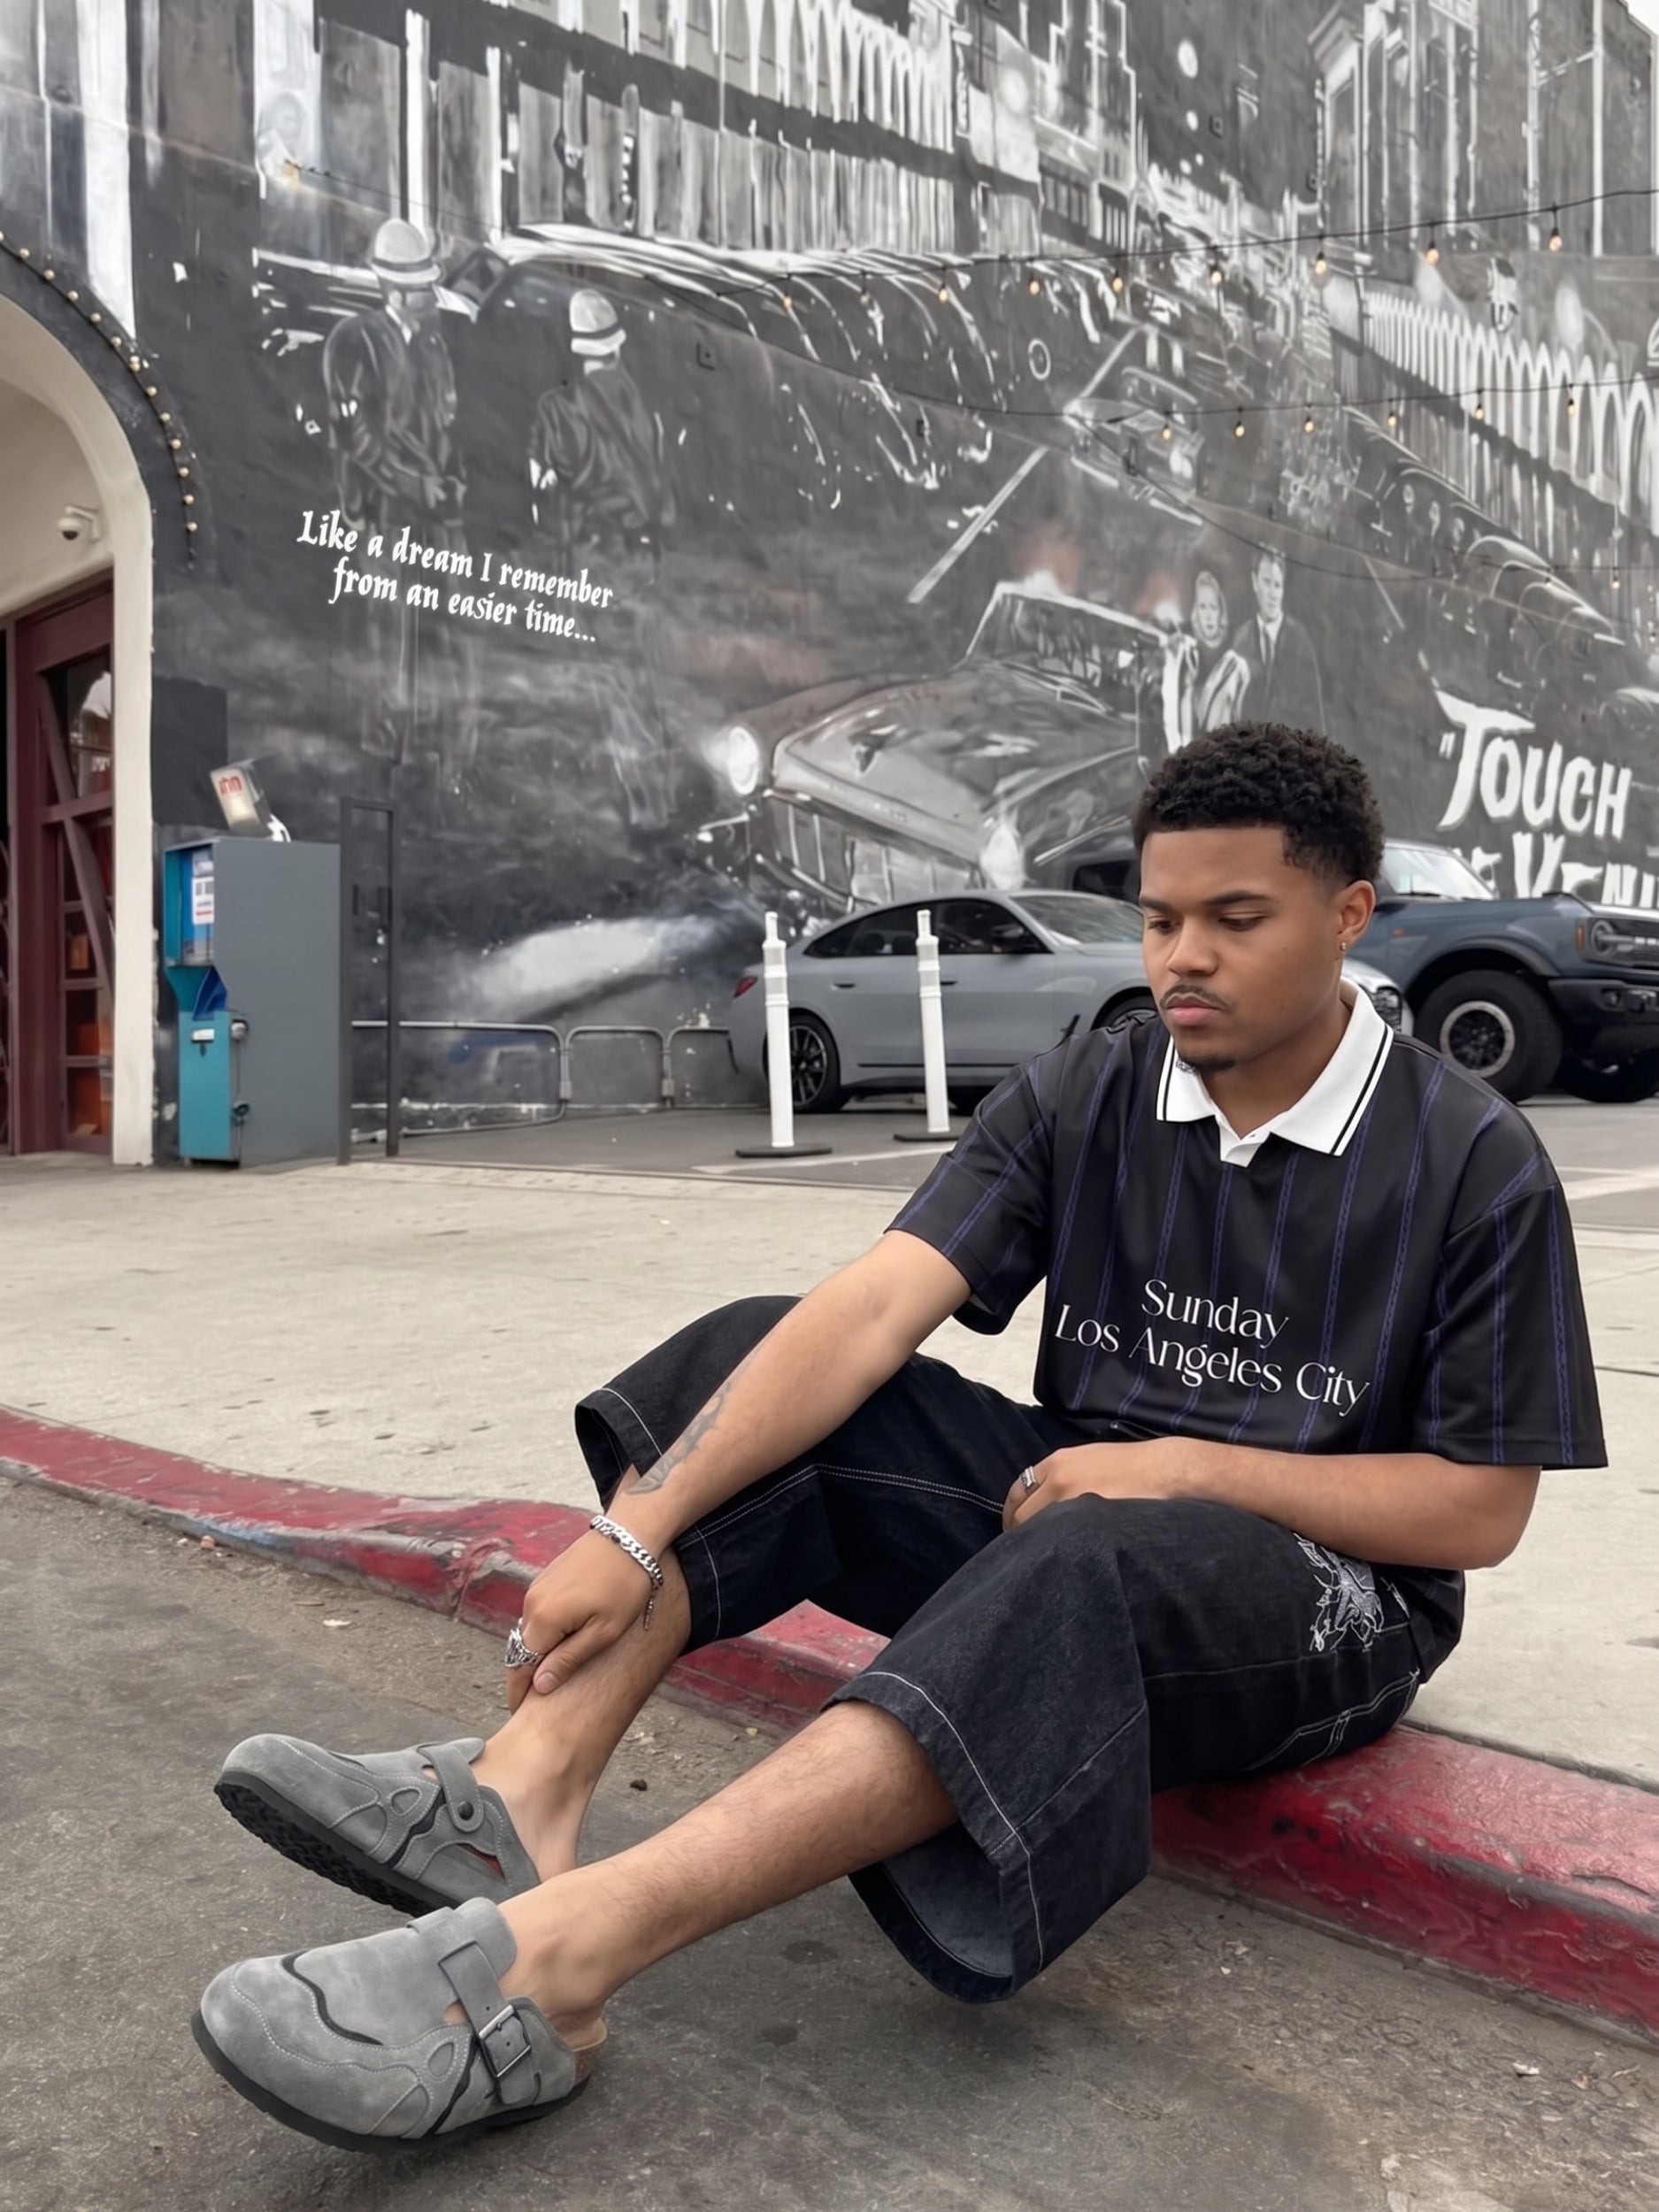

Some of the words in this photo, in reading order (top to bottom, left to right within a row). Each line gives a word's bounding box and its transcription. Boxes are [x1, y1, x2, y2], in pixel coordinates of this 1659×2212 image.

[296, 509, 358, 554] Like
[366, 534, 384, 559] a
[392, 526, 473, 579] dream
[480, 552, 494, 582] I
[498, 566, 614, 609] remember
[327, 556, 398, 604] from
[405, 583, 440, 611] an
[448, 592, 518, 626] easier
[524, 598, 596, 643] time...
[1054, 1304, 1121, 1353] Los
[1127, 1327, 1283, 1394] Angeles
[1294, 1361, 1371, 1417] City
[1141, 1279, 1290, 1350] Sunday
